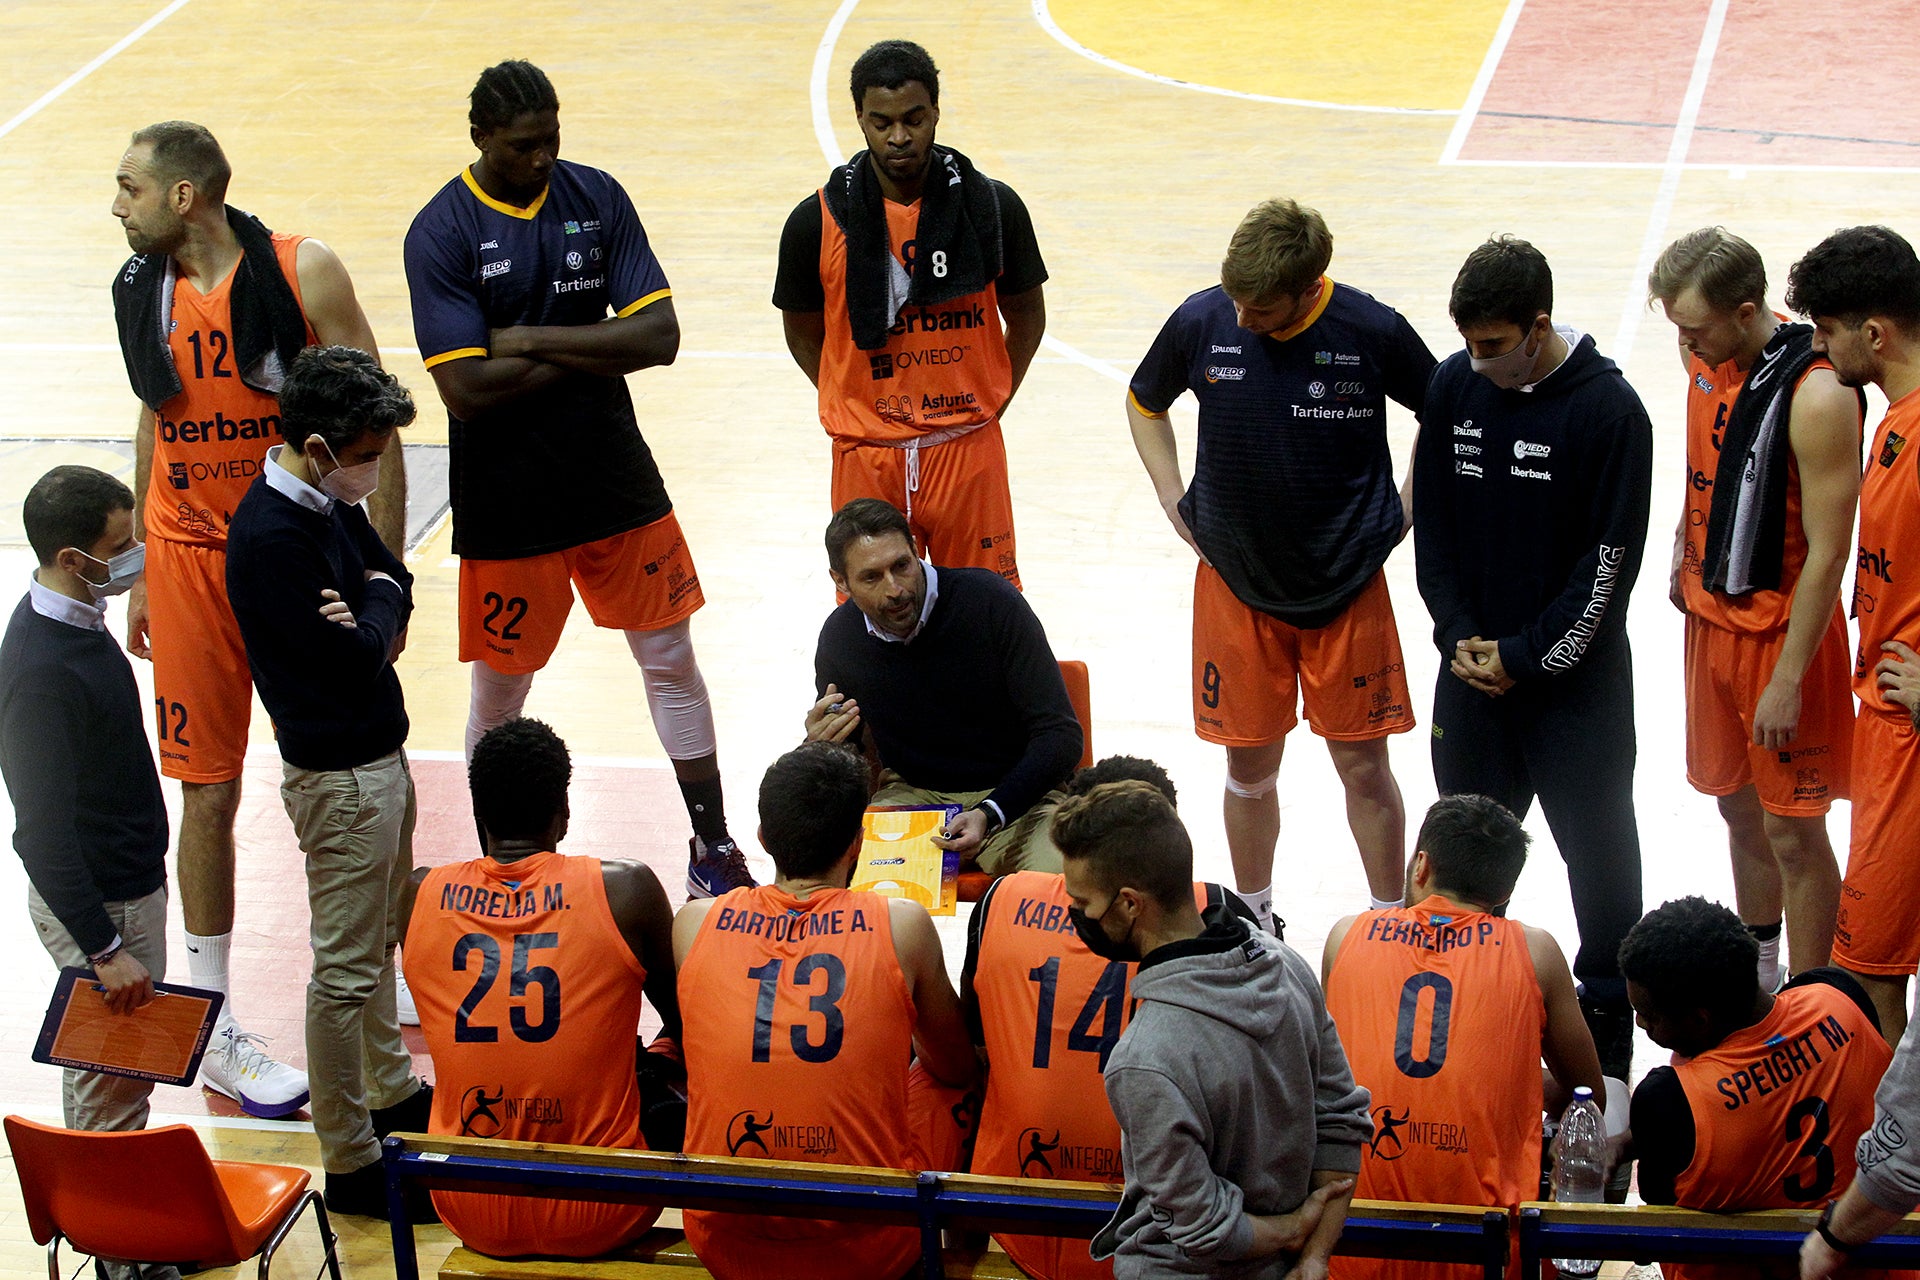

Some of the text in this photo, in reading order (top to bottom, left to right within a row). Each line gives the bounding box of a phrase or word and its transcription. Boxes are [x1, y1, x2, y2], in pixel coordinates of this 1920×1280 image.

[931, 250, 948, 278] 8
[552, 276, 601, 294] Tartiere
[187, 328, 232, 380] 12
[896, 345, 965, 369] OVIEDO
[1211, 344, 1242, 355] SPALDING
[1208, 366, 1247, 377] OVIEDO
[1290, 404, 1374, 419] Tartiere Auto
[1517, 441, 1551, 454] OVIEDO
[1511, 465, 1552, 481] Liberbank
[482, 591, 529, 641] 22
[1201, 661, 1221, 709] 9
[155, 695, 190, 747] 12
[1792, 744, 1830, 759] OVIEDO
[439, 882, 572, 919] NORELIA M.
[715, 907, 874, 943] BARTOLOME A.
[1367, 917, 1501, 953] FERREIRO P.
[452, 931, 562, 1043] 25
[746, 952, 847, 1064] 13
[1028, 956, 1128, 1074] 14
[1394, 970, 1453, 1079] 0
[1716, 1014, 1856, 1112] SPEIGHT M.
[504, 1097, 563, 1120] INTEGRA
[773, 1125, 838, 1149] INTEGRA
[1408, 1121, 1469, 1148] INTEGRA
[1783, 1095, 1836, 1202] 3
